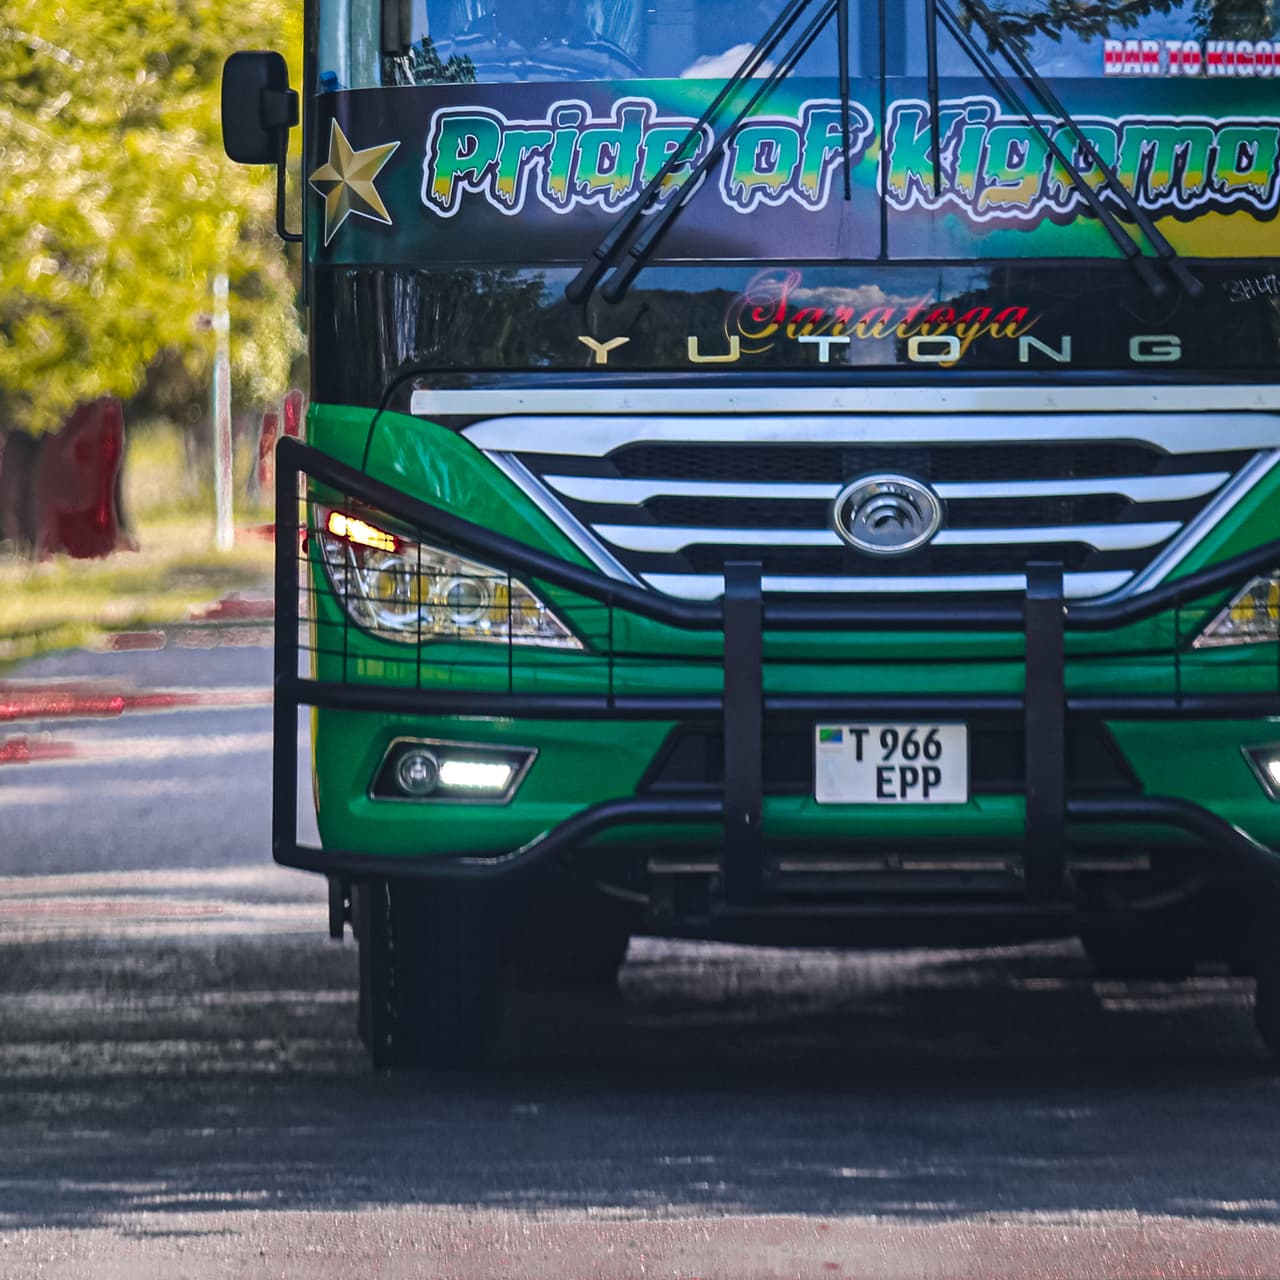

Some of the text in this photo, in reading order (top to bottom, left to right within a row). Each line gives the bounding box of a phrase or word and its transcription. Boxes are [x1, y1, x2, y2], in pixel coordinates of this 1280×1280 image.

[1104, 40, 1161, 74] DAR
[1167, 40, 1203, 75] TO
[424, 99, 713, 215] Pride
[726, 268, 1038, 367] Saratoga
[578, 335, 1181, 364] YUTONG
[849, 728, 942, 761] T 966
[876, 765, 942, 798] EPP
